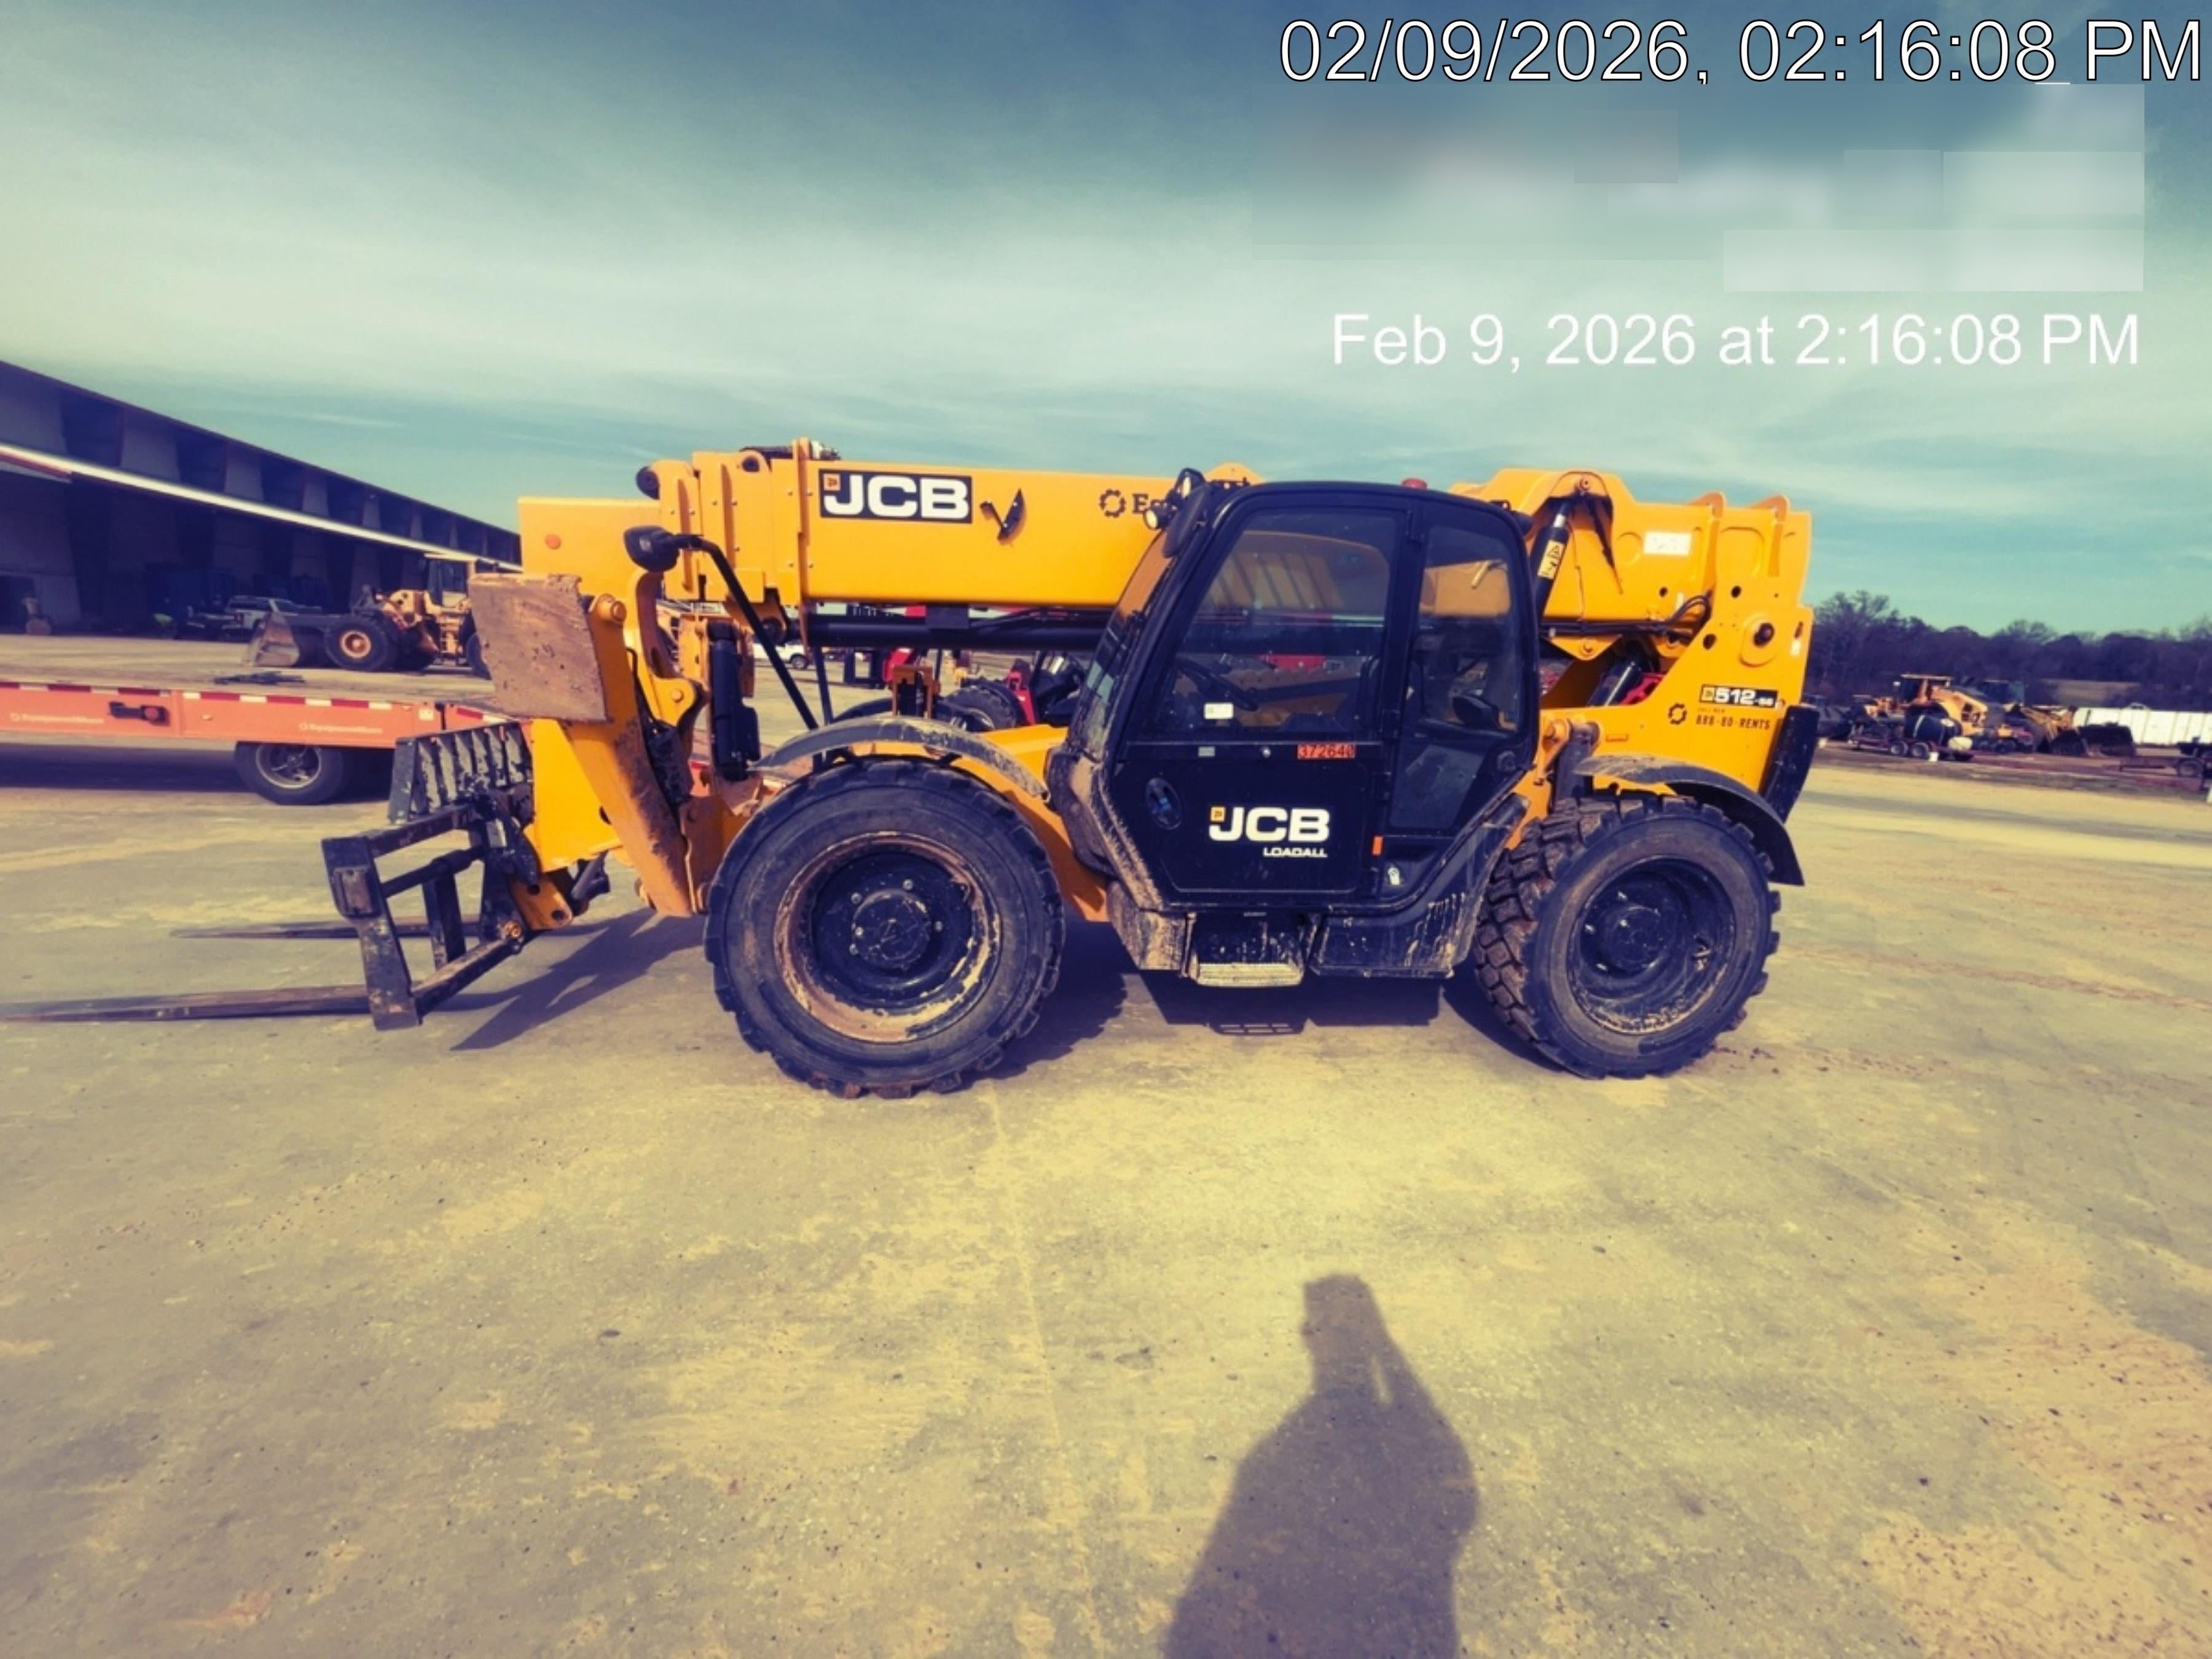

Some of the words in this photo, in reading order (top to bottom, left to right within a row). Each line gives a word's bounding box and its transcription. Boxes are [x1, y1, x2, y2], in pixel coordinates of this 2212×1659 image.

[823, 474, 969, 519] JCB
[1209, 807, 1330, 842] JCB
[1263, 847, 1328, 858] LOADALL
